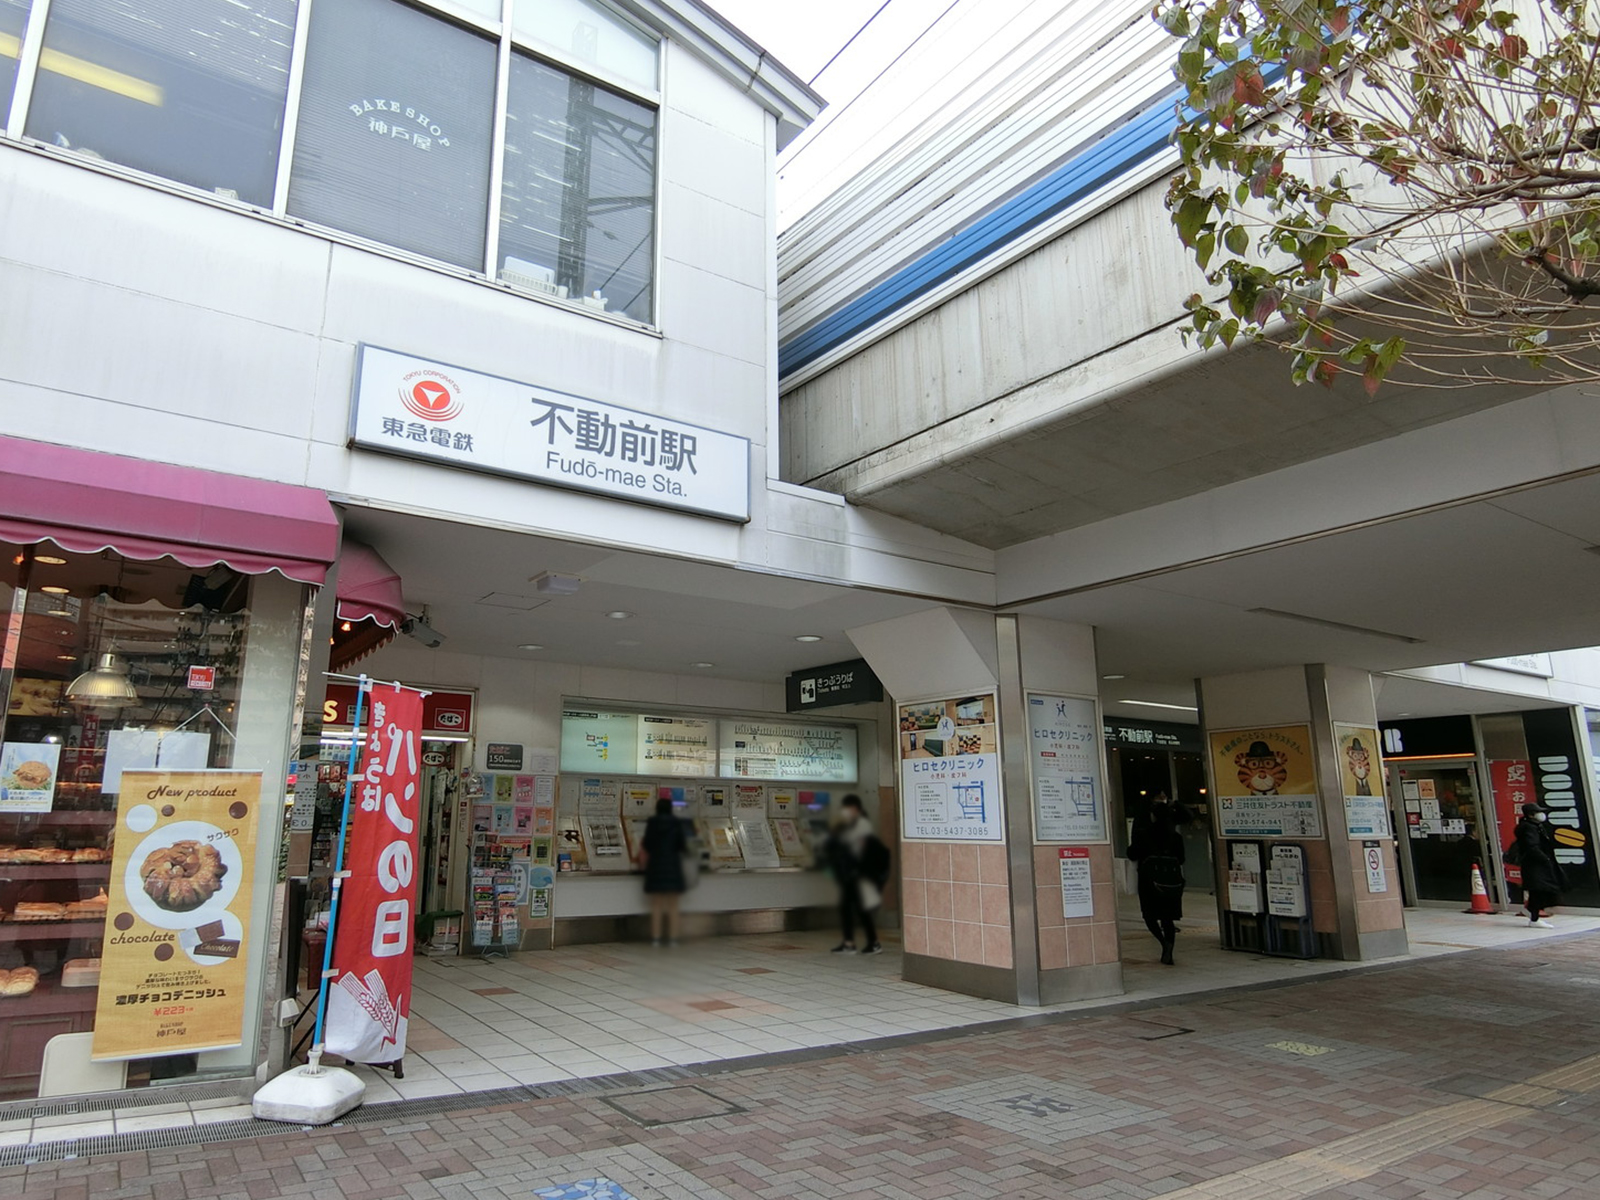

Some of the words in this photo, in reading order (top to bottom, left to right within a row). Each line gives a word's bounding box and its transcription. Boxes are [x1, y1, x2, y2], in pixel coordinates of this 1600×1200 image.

[349, 99, 400, 117] BAKE
[405, 107, 450, 147] SHOP
[368, 117, 432, 152] 神戸屋
[403, 370, 422, 382] TOKYU
[423, 369, 461, 394] CORPORATION
[381, 416, 474, 453] 東急電鉄
[530, 397, 697, 475] 不動前駅
[546, 451, 646, 488] Fudō-mae
[652, 473, 688, 497] Sta.
[817, 671, 854, 687] きっぷうりば
[1034, 728, 1093, 741] ヒロセクリニック
[361, 701, 386, 811] きょうは
[913, 758, 984, 772] ヒロセクリニック
[147, 785, 184, 800] New
[184, 786, 237, 801] product
[1538, 755, 1586, 864] DOUTOR
[206, 828, 239, 842] サクサク
[371, 722, 417, 957] パンの日
[110, 930, 175, 945] chocolate
[115, 988, 226, 1006] 濃厚チョコデニッシュ
